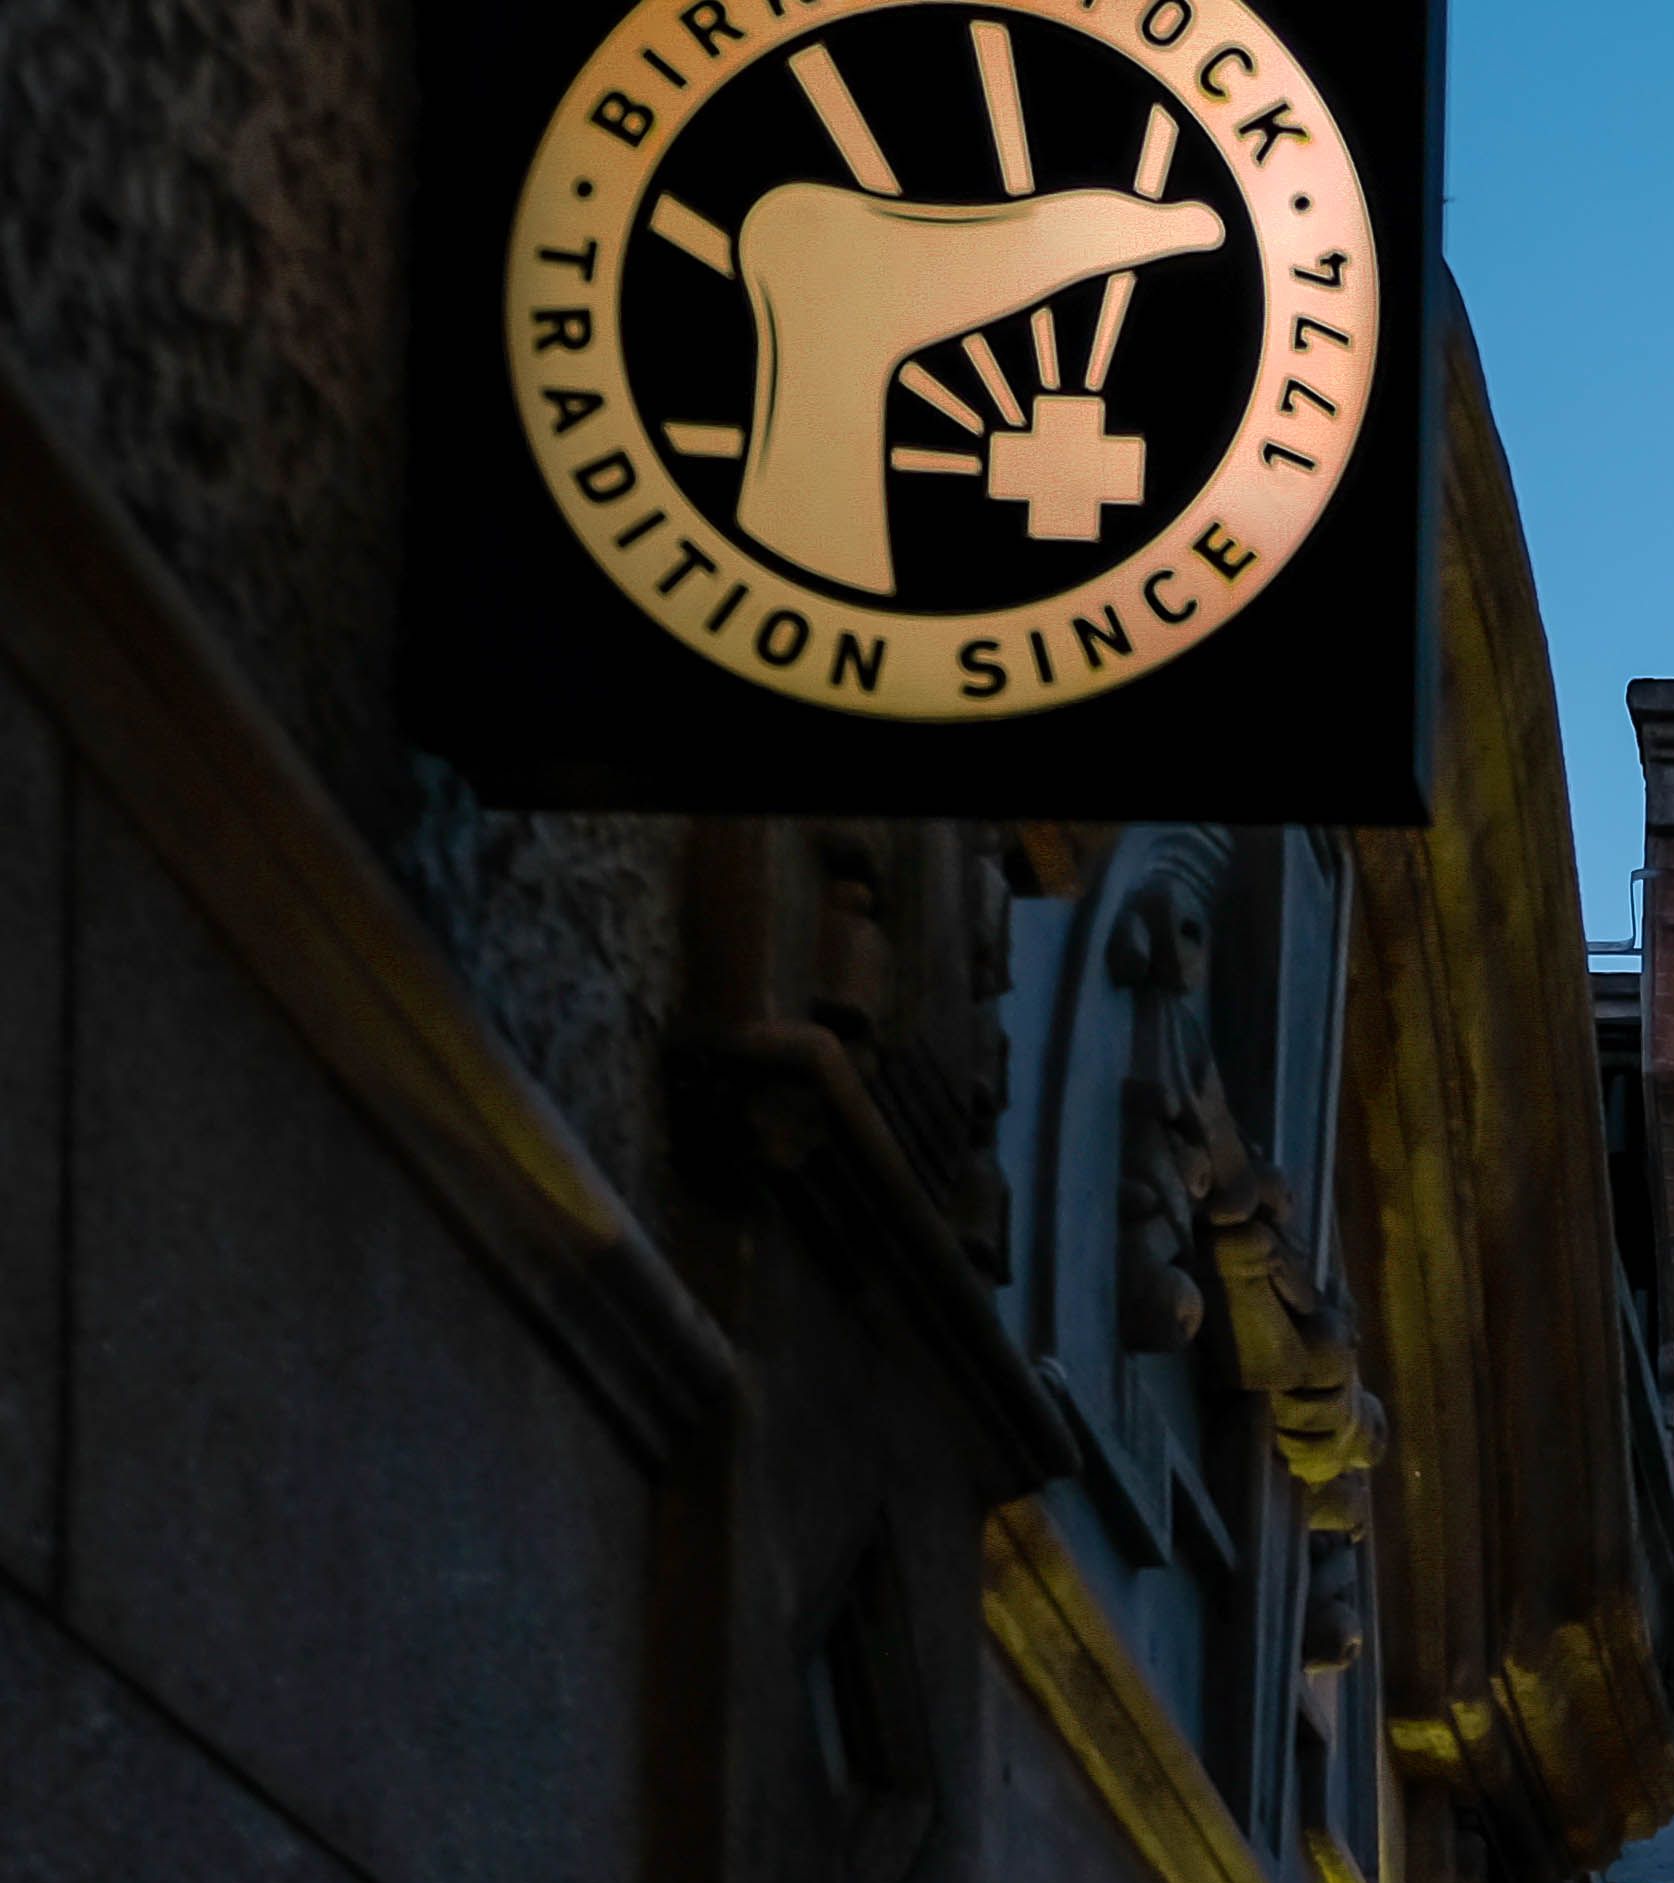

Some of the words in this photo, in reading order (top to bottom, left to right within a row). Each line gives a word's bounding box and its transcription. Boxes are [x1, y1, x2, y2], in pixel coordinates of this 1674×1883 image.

[531, 237, 886, 693] TRADITION
[957, 523, 1256, 701] SINCE
[1263, 254, 1348, 470] 1774
